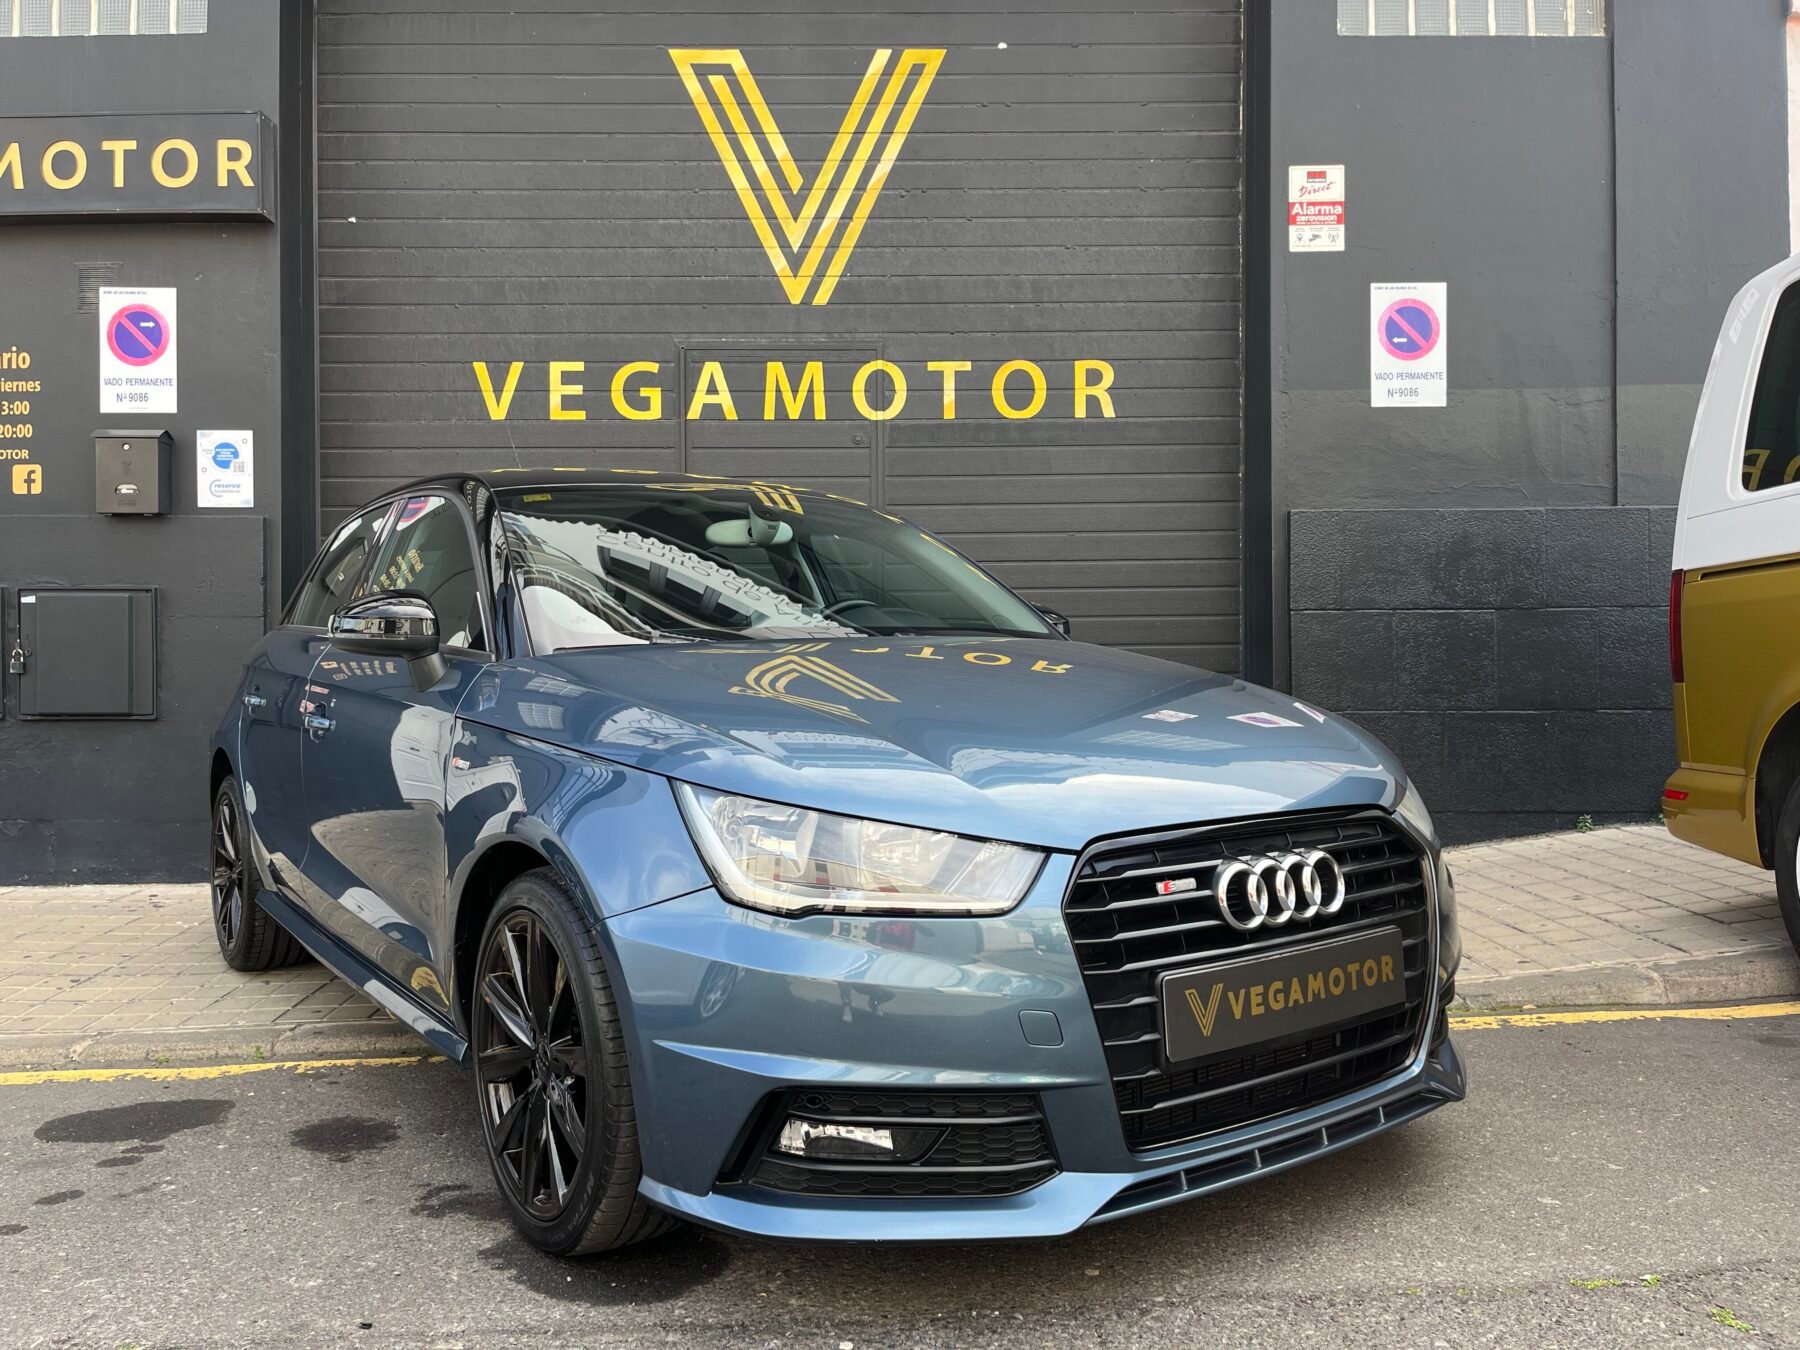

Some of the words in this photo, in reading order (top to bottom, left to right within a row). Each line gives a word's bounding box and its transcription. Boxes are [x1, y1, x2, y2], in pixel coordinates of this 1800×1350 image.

[1291, 202, 1342, 215] Alarma
[1296, 214, 1337, 222] zerovision
[0, 346, 31, 369] rio
[103, 377, 123, 387] VADO
[125, 378, 174, 387] PERMANENTE
[1374, 372, 1394, 381] VADO
[1396, 372, 1444, 380] PERMANENTE
[0, 378, 41, 392] iernes
[473, 359, 1117, 421] VEGAMOTOR
[1, 400, 30, 415] 3:00
[0, 424, 33, 438] 20:00
[1227, 954, 1395, 1020] VEGAMOTOR
